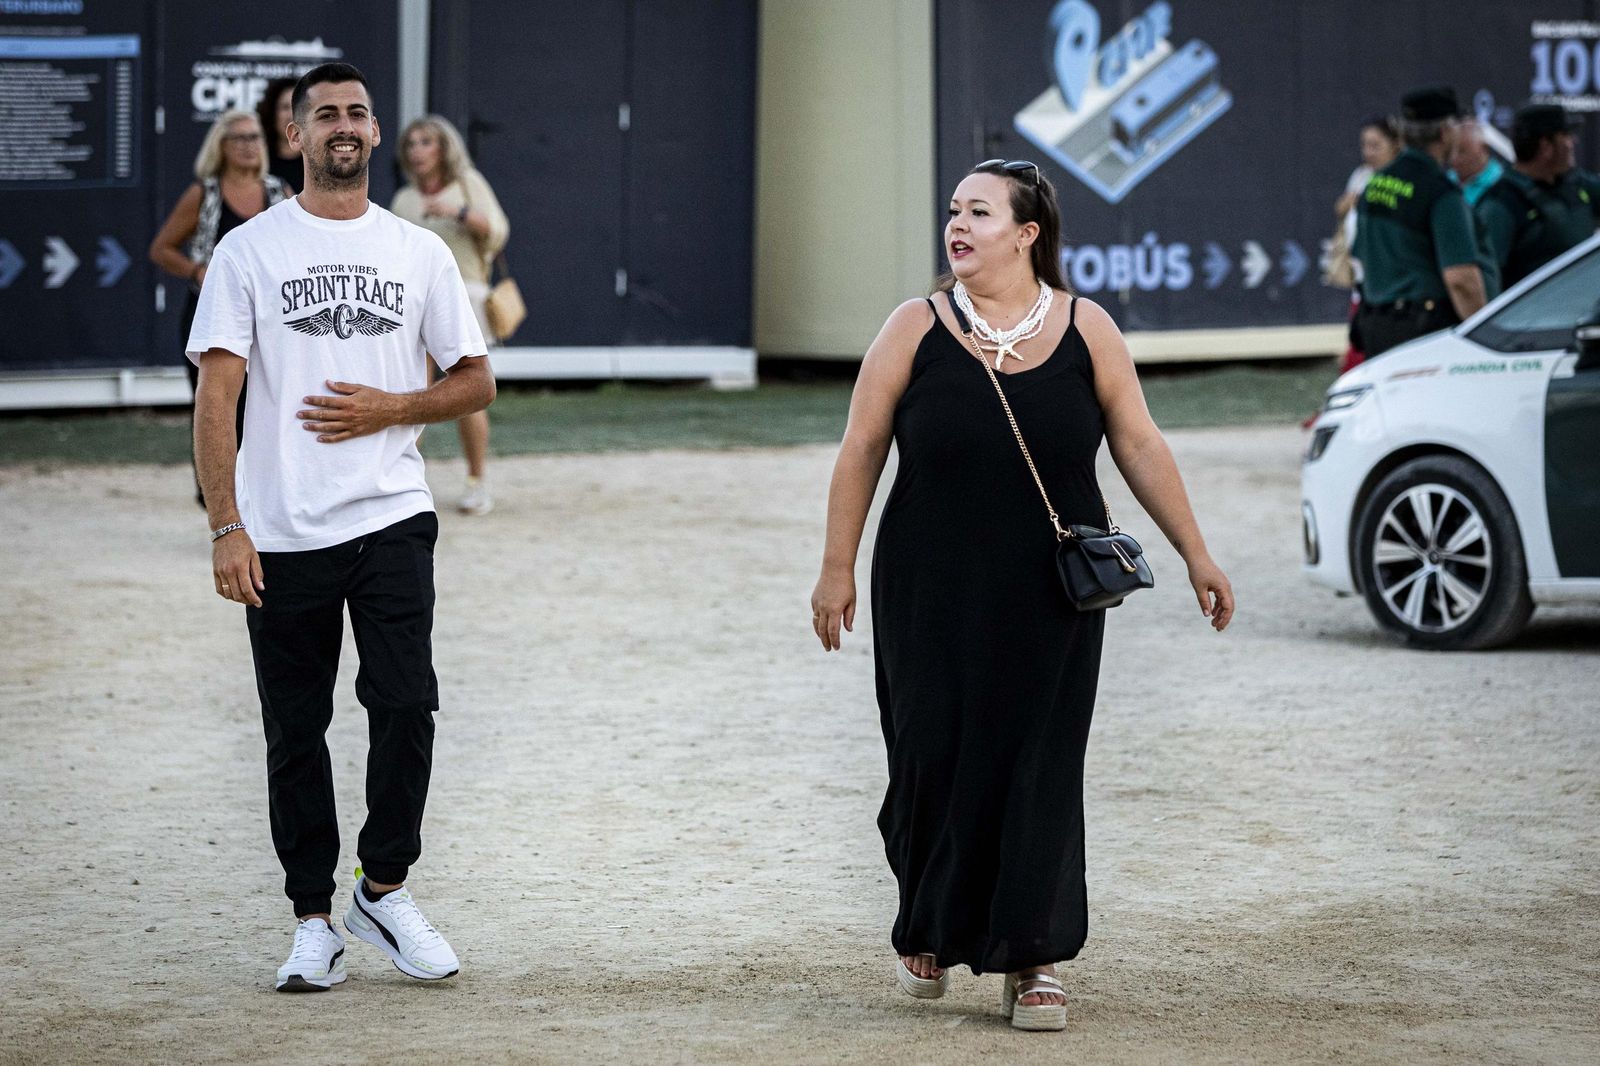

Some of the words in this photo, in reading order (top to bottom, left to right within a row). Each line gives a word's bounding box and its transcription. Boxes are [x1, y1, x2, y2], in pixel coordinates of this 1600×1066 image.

[1530, 39, 1600, 96] 10
[307, 264, 345, 275] MOTOR
[347, 265, 378, 276] VIBES
[281, 275, 350, 314] SPRINT
[354, 275, 404, 316] RACE
